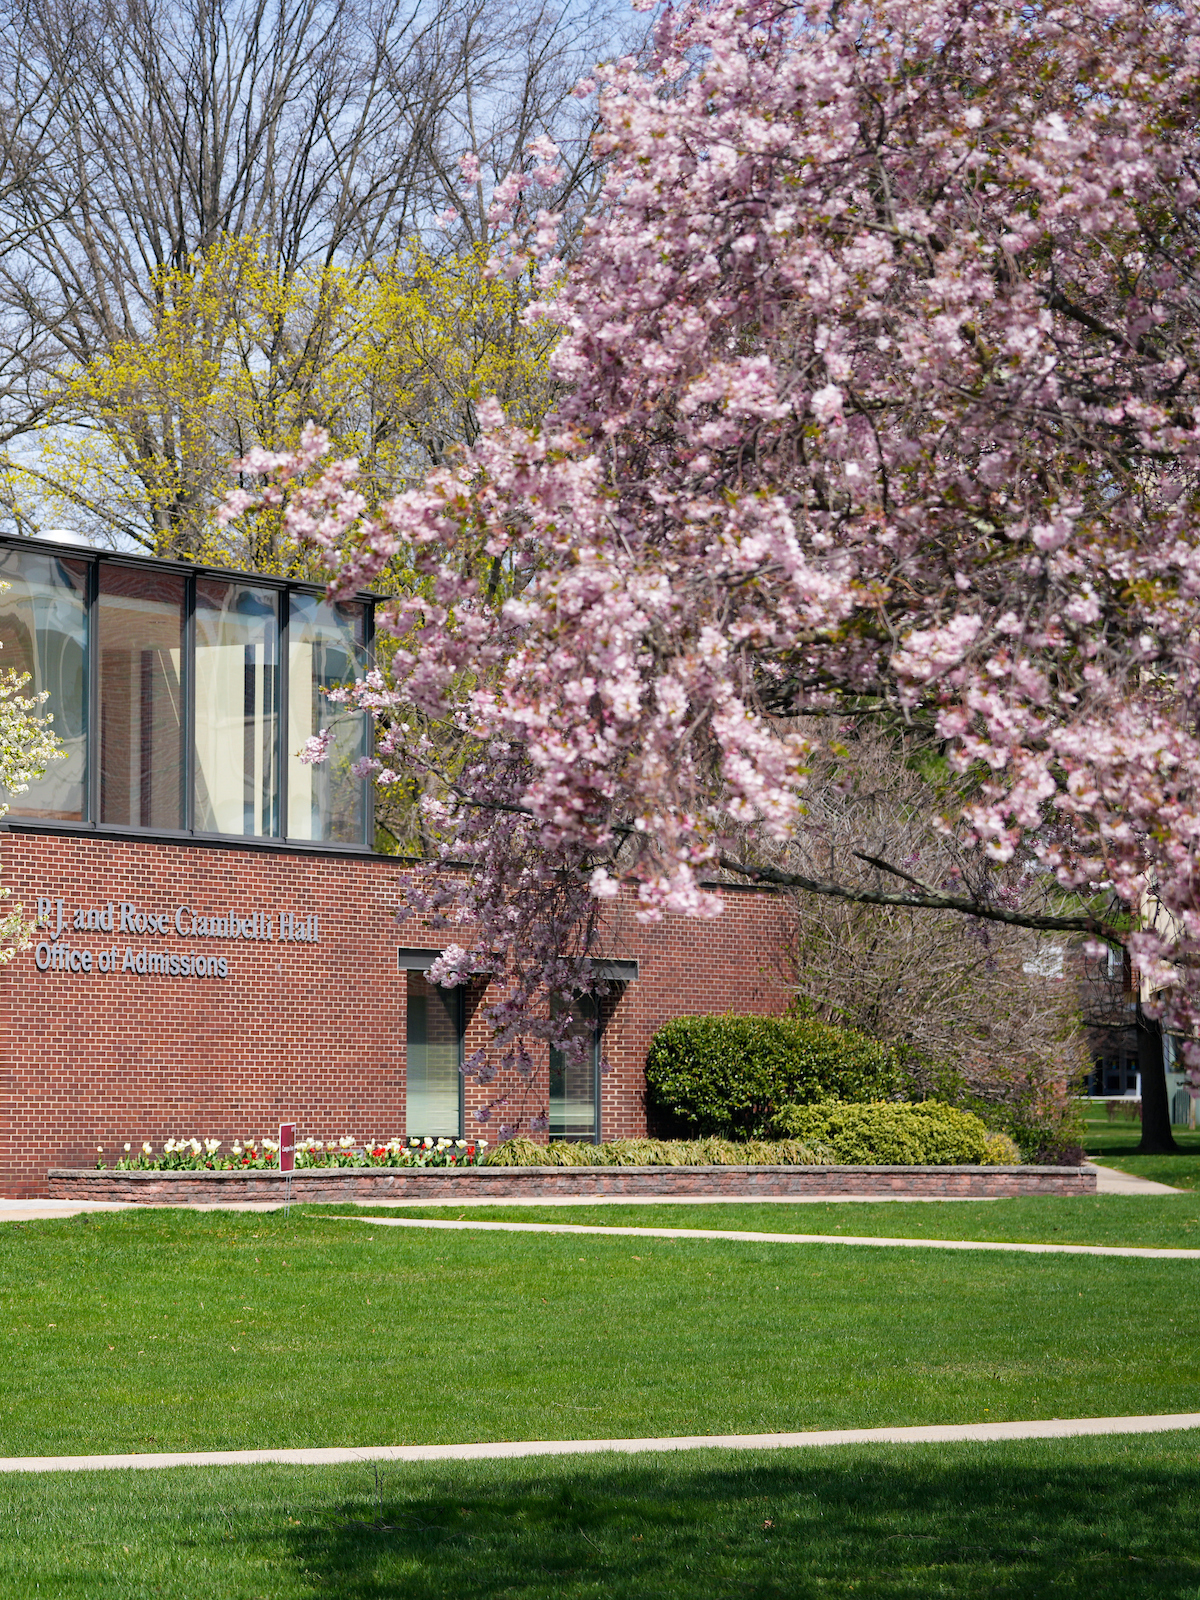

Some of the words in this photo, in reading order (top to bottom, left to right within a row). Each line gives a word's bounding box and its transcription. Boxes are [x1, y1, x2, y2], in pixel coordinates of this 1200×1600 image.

[36, 897, 68, 940] P.J.
[73, 901, 114, 931] and
[119, 902, 170, 934] Rose
[175, 906, 272, 939] Ciambelli
[278, 912, 319, 942] Hall
[35, 942, 93, 972] Office
[98, 945, 117, 972] of
[122, 946, 229, 977] Admissions
